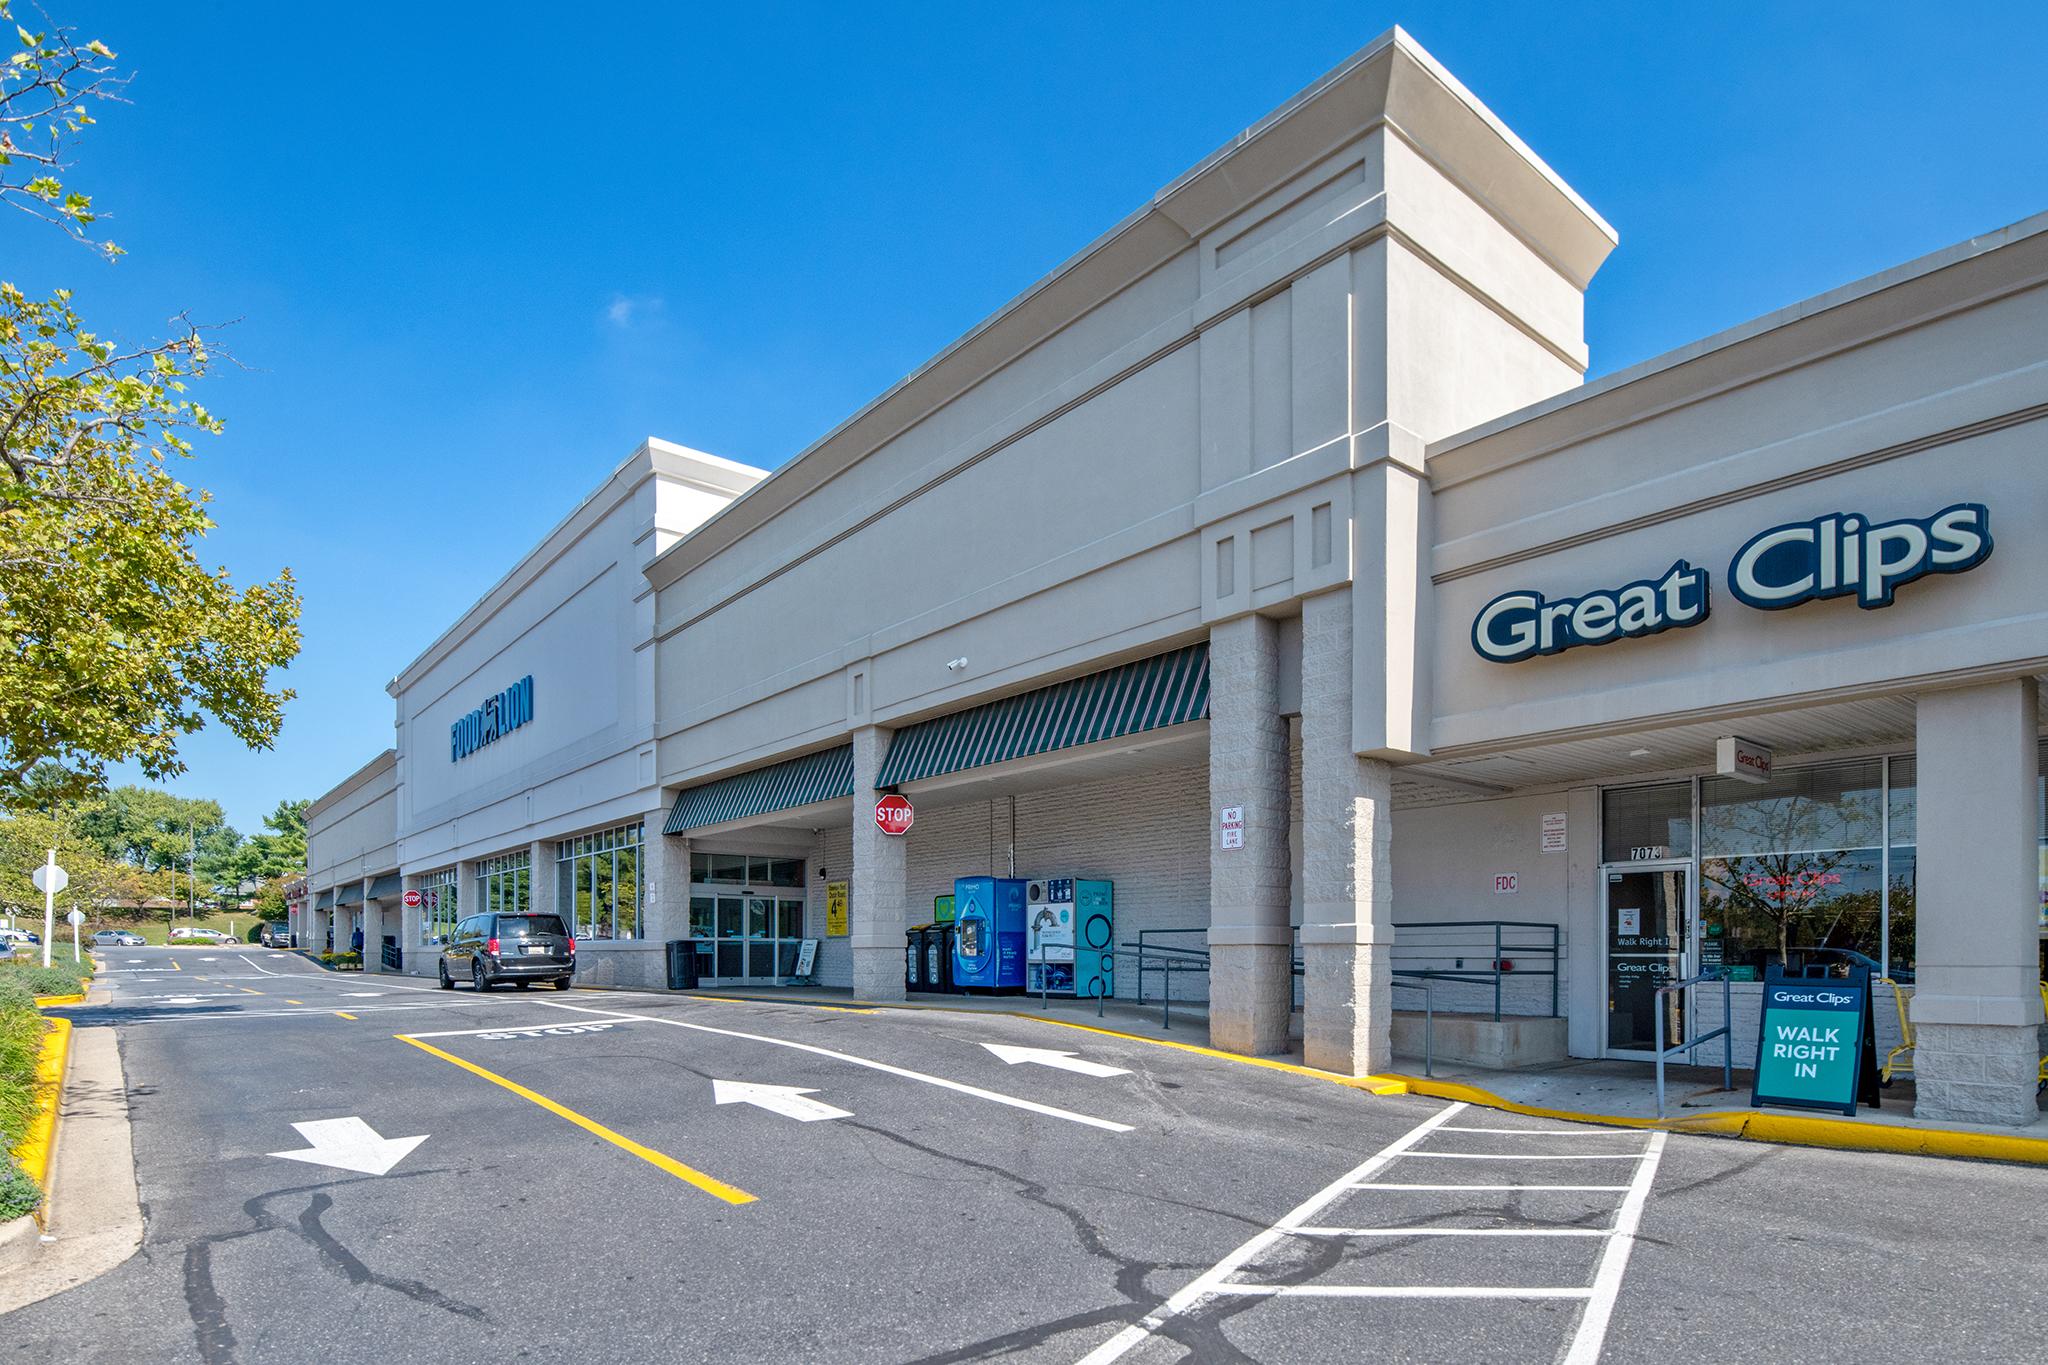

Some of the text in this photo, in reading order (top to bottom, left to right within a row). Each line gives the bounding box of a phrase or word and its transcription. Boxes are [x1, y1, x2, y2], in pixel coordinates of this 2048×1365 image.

[1476, 508, 1982, 657] Great Clips
[451, 674, 534, 763] FOOD LION
[1737, 750, 1755, 767] Great
[877, 807, 912, 822] STOP
[1227, 811, 1237, 820] NO
[1221, 821, 1243, 830] PARKING
[1226, 838, 1239, 846] LANE
[1496, 876, 1516, 890] FDC
[404, 895, 421, 903] STOP
[1617, 937, 1637, 946] Walk
[1639, 937, 1663, 948] Right
[1617, 962, 1673, 975] Great Clips
[1774, 991, 1851, 1006] Great Clips
[476, 1024, 614, 1040] STOP
[1776, 1026, 1840, 1043] WALK
[1773, 1043, 1840, 1061] RIGHT
[1794, 1062, 1817, 1078] IN
